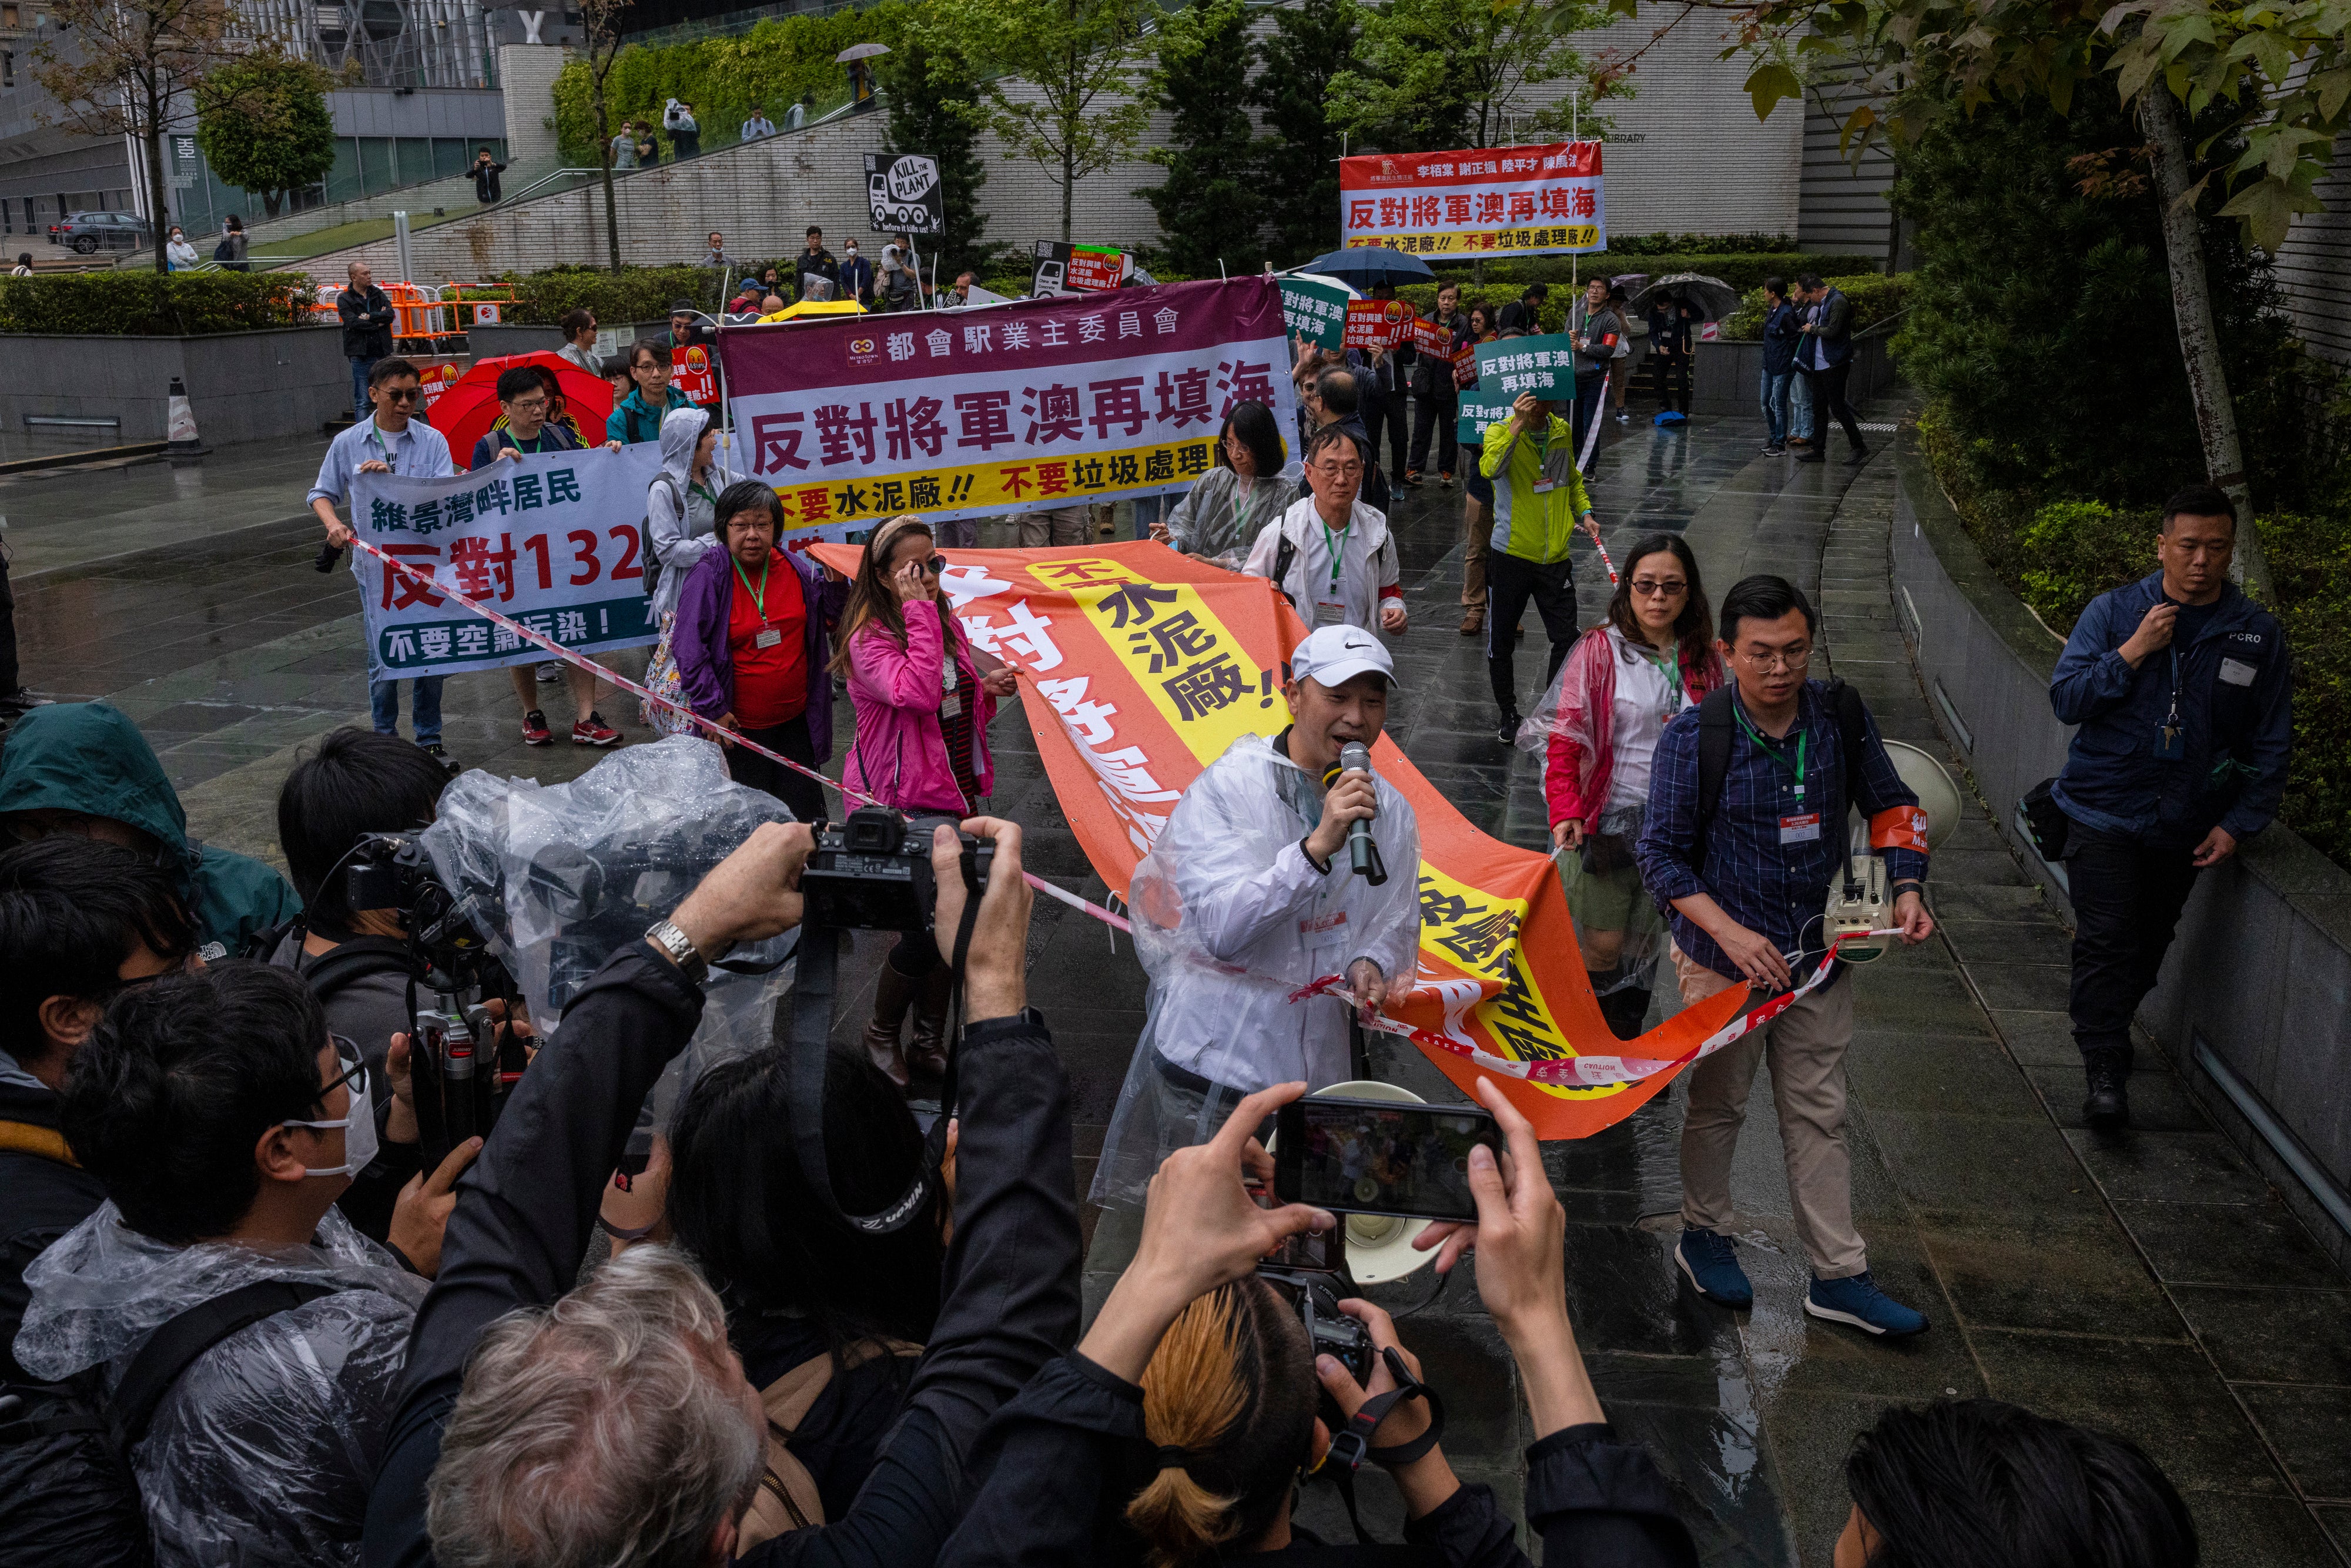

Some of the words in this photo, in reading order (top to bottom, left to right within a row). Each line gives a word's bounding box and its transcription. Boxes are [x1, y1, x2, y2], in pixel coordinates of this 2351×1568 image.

[1607, 133, 1646, 143] LIBRARY
[893, 159, 919, 180] KILL
[918, 162, 929, 172] THE
[1459, 160, 1497, 176] 謝正楓
[1502, 158, 1539, 173] 陸平才
[895, 173, 930, 197] PLANT
[1348, 186, 1596, 230] 反對將軍澳再填海
[882, 223, 900, 231] before
[907, 225, 919, 233] kills
[1463, 228, 1595, 250] 不要垃圾處理廠!!
[1070, 267, 1093, 277] 水泥廠
[1071, 258, 1101, 269] 反對興建
[1280, 289, 1344, 321] 對將軍澳
[1283, 310, 1326, 336] 再填海
[1348, 313, 1383, 323] 反對興建
[886, 307, 1179, 361] 都會駅業主委員會
[1348, 324, 1374, 334] 水泥廠
[1481, 350, 1570, 377] 反對將軍澳
[423, 381, 445, 394] 反對興建
[1501, 371, 1555, 393] 再填海
[752, 360, 1276, 477] 反對將軍澳再填海
[370, 468, 581, 535] 維景灣畔居民
[2229, 632, 2261, 643] PCRO
[200, 943, 213, 951] THE
[885, 1180, 923, 1224] Nikon
